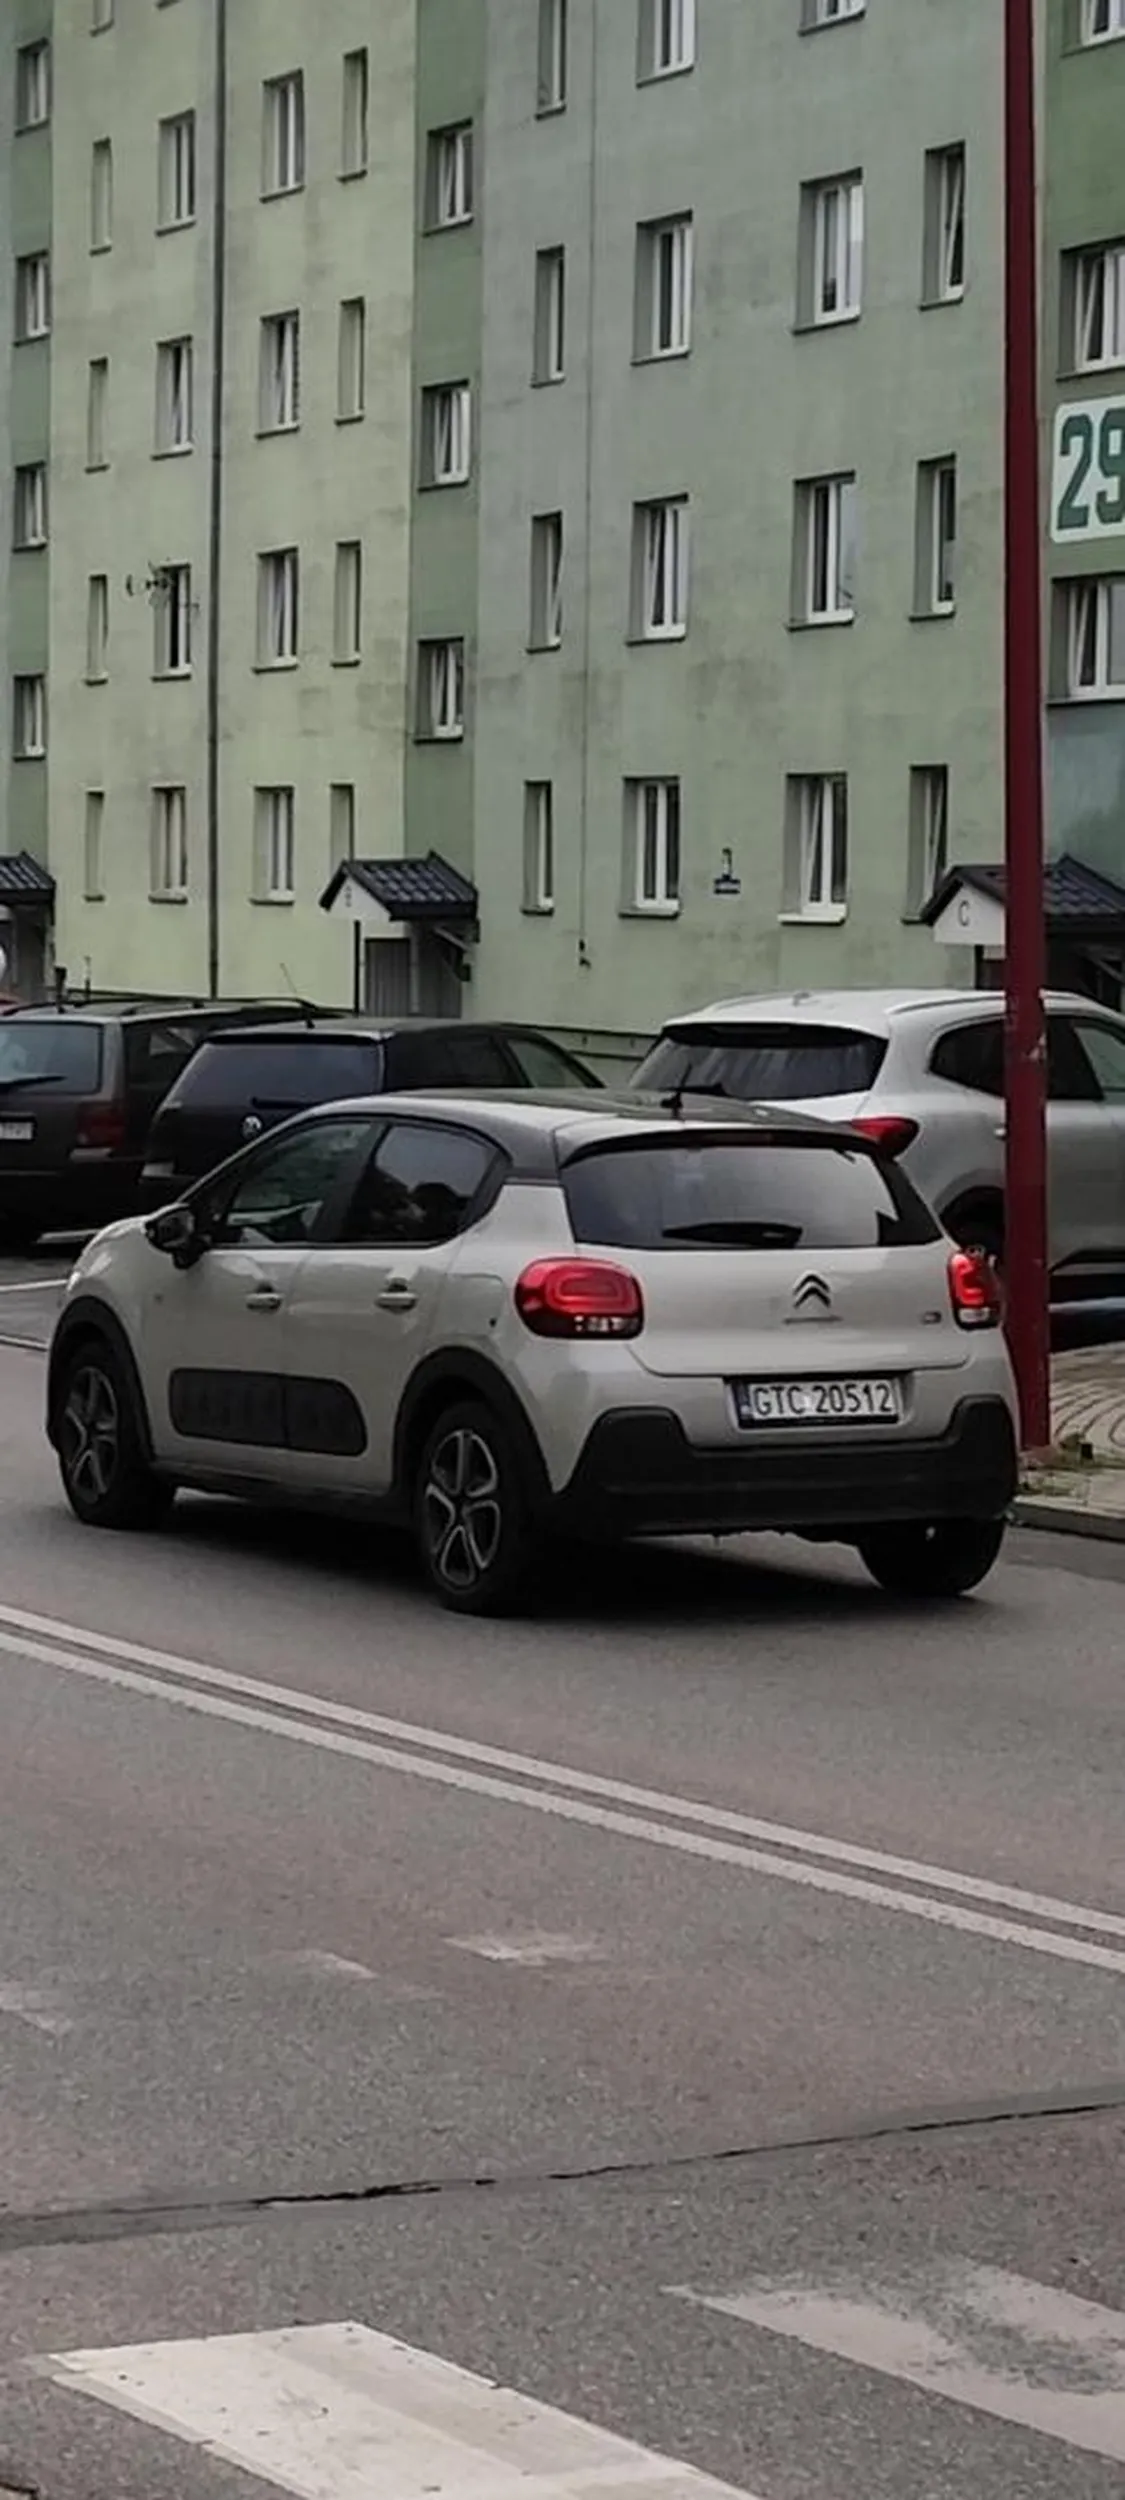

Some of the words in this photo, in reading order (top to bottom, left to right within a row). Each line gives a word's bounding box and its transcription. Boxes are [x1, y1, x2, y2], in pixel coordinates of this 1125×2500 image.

[1057, 407, 1125, 530] 29
[957, 900, 970, 926] C
[753, 1385, 805, 1416] GTC
[812, 1382, 893, 1413] 20512
